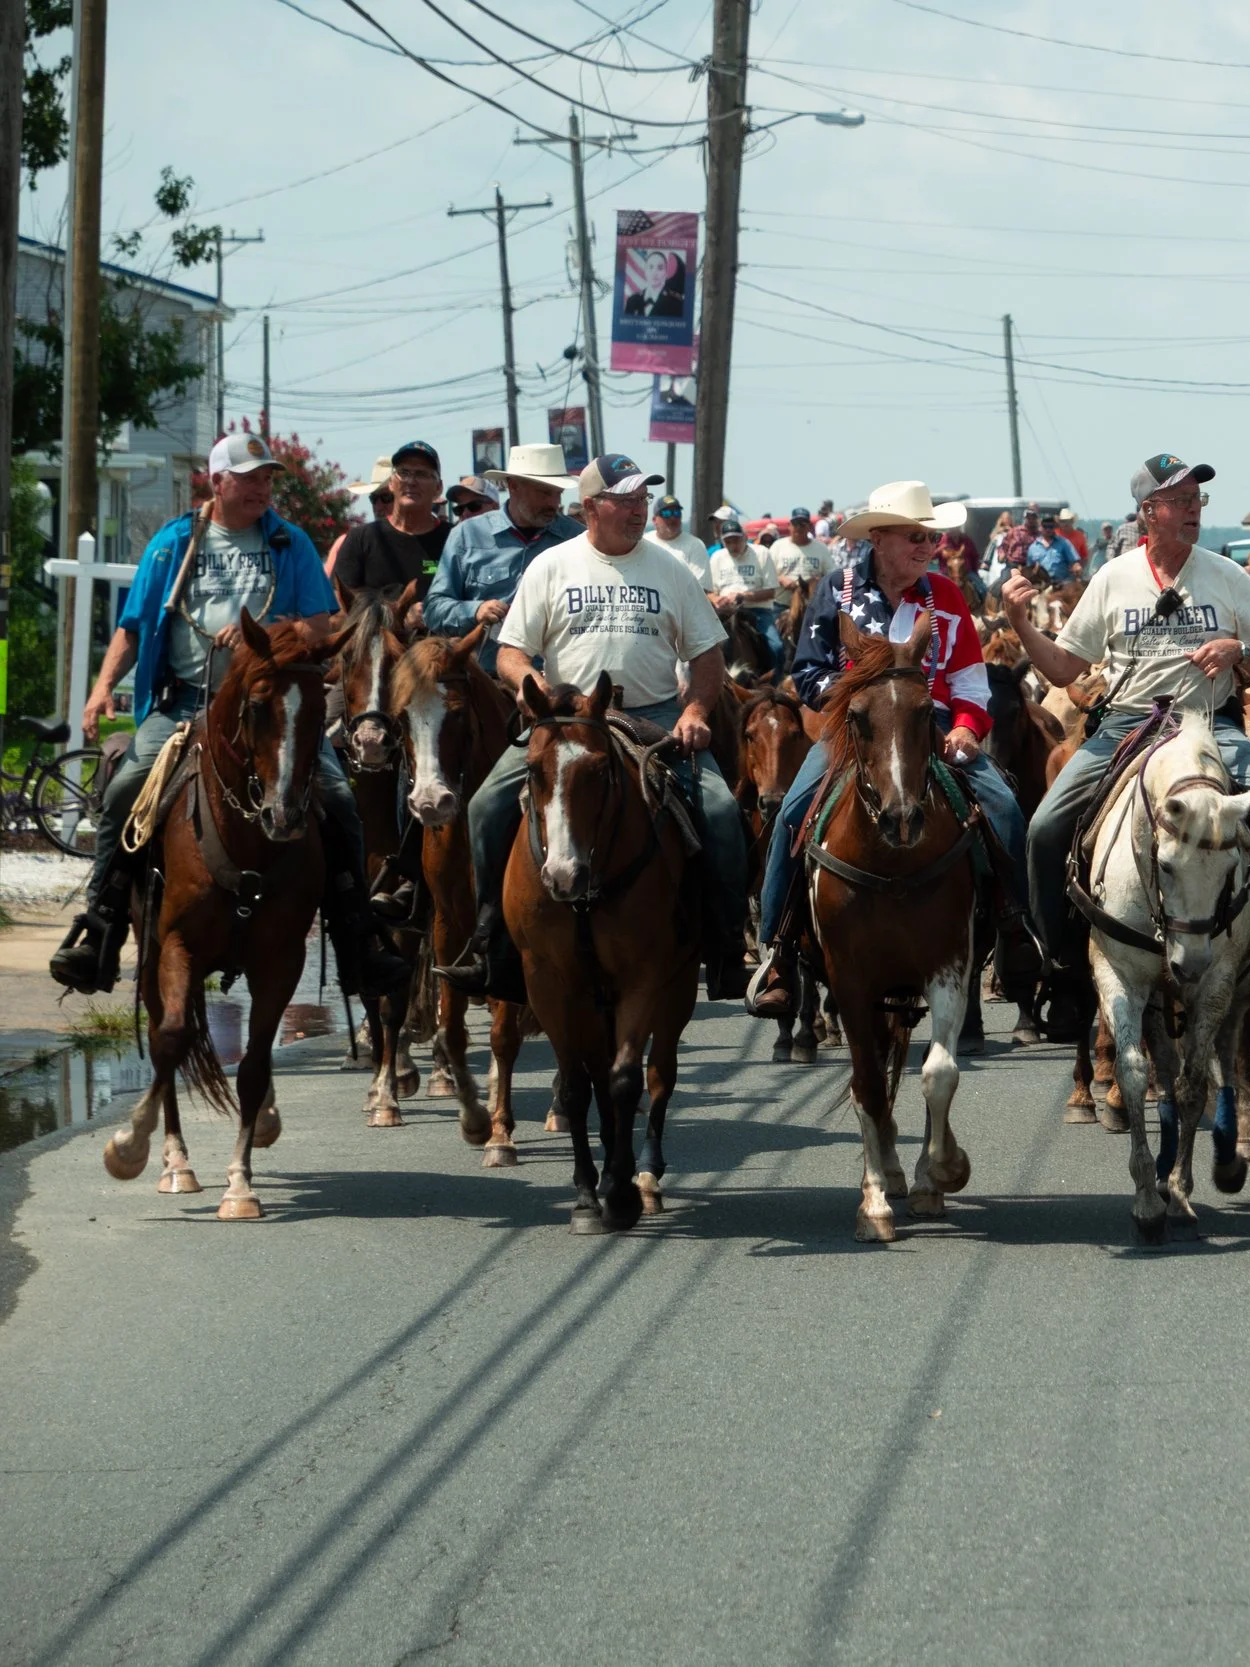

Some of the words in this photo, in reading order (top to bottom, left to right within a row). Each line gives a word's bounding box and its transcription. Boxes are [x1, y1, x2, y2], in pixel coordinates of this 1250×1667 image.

[194, 552, 235, 578] BILLY
[240, 551, 271, 574] REED
[566, 585, 614, 615] BILLY
[619, 585, 661, 615] REED
[569, 625, 624, 635] CHINCOTEAGUE
[1142, 627, 1172, 635] QUALITY
[1173, 625, 1204, 635] BUILDER
[1176, 604, 1219, 632] REED
